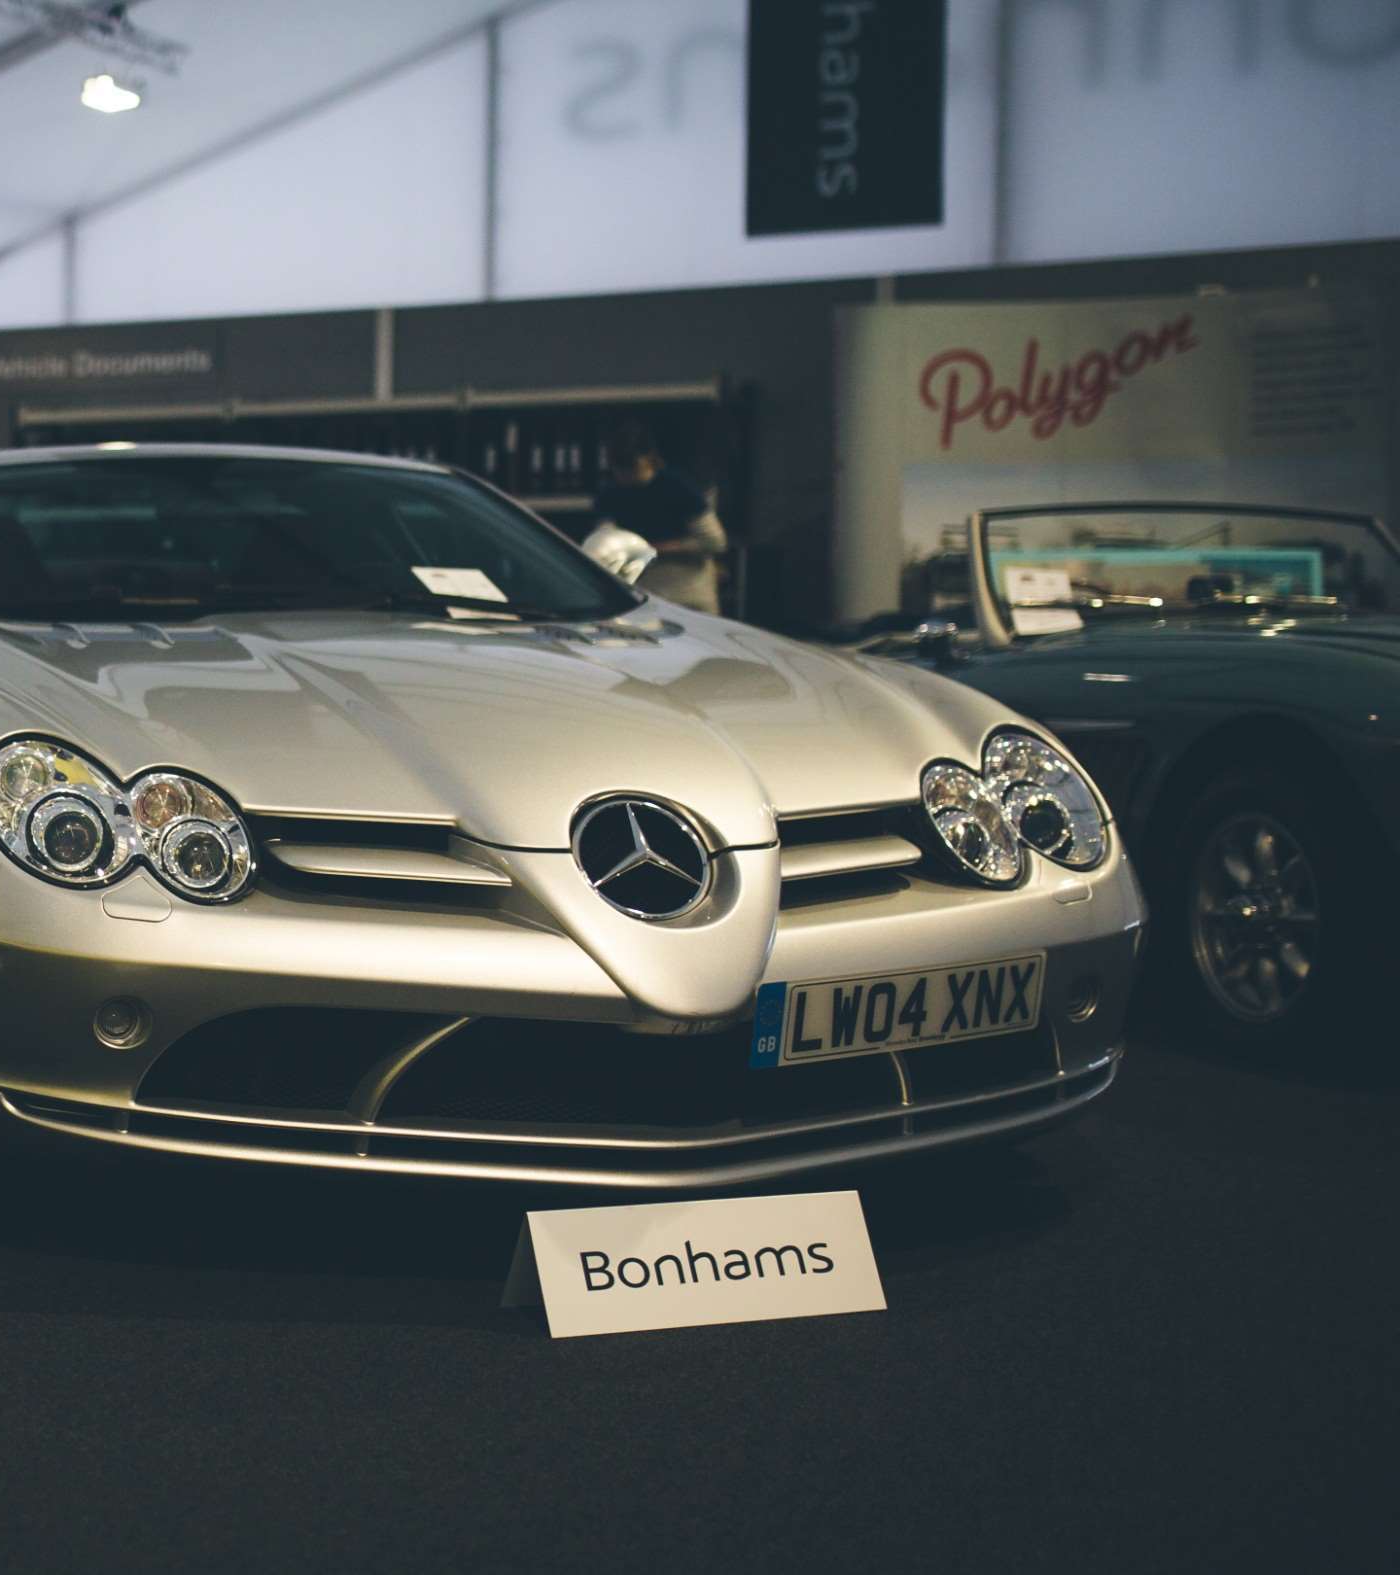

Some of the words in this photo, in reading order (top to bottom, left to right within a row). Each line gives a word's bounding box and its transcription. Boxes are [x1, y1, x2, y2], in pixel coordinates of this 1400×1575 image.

[72, 349, 213, 379] Documents
[919, 312, 1200, 450] Polygon
[791, 976, 928, 1053] LW04
[941, 961, 1037, 1033] XNX
[757, 1036, 777, 1053] GB
[579, 1240, 834, 1292] Bonhams
